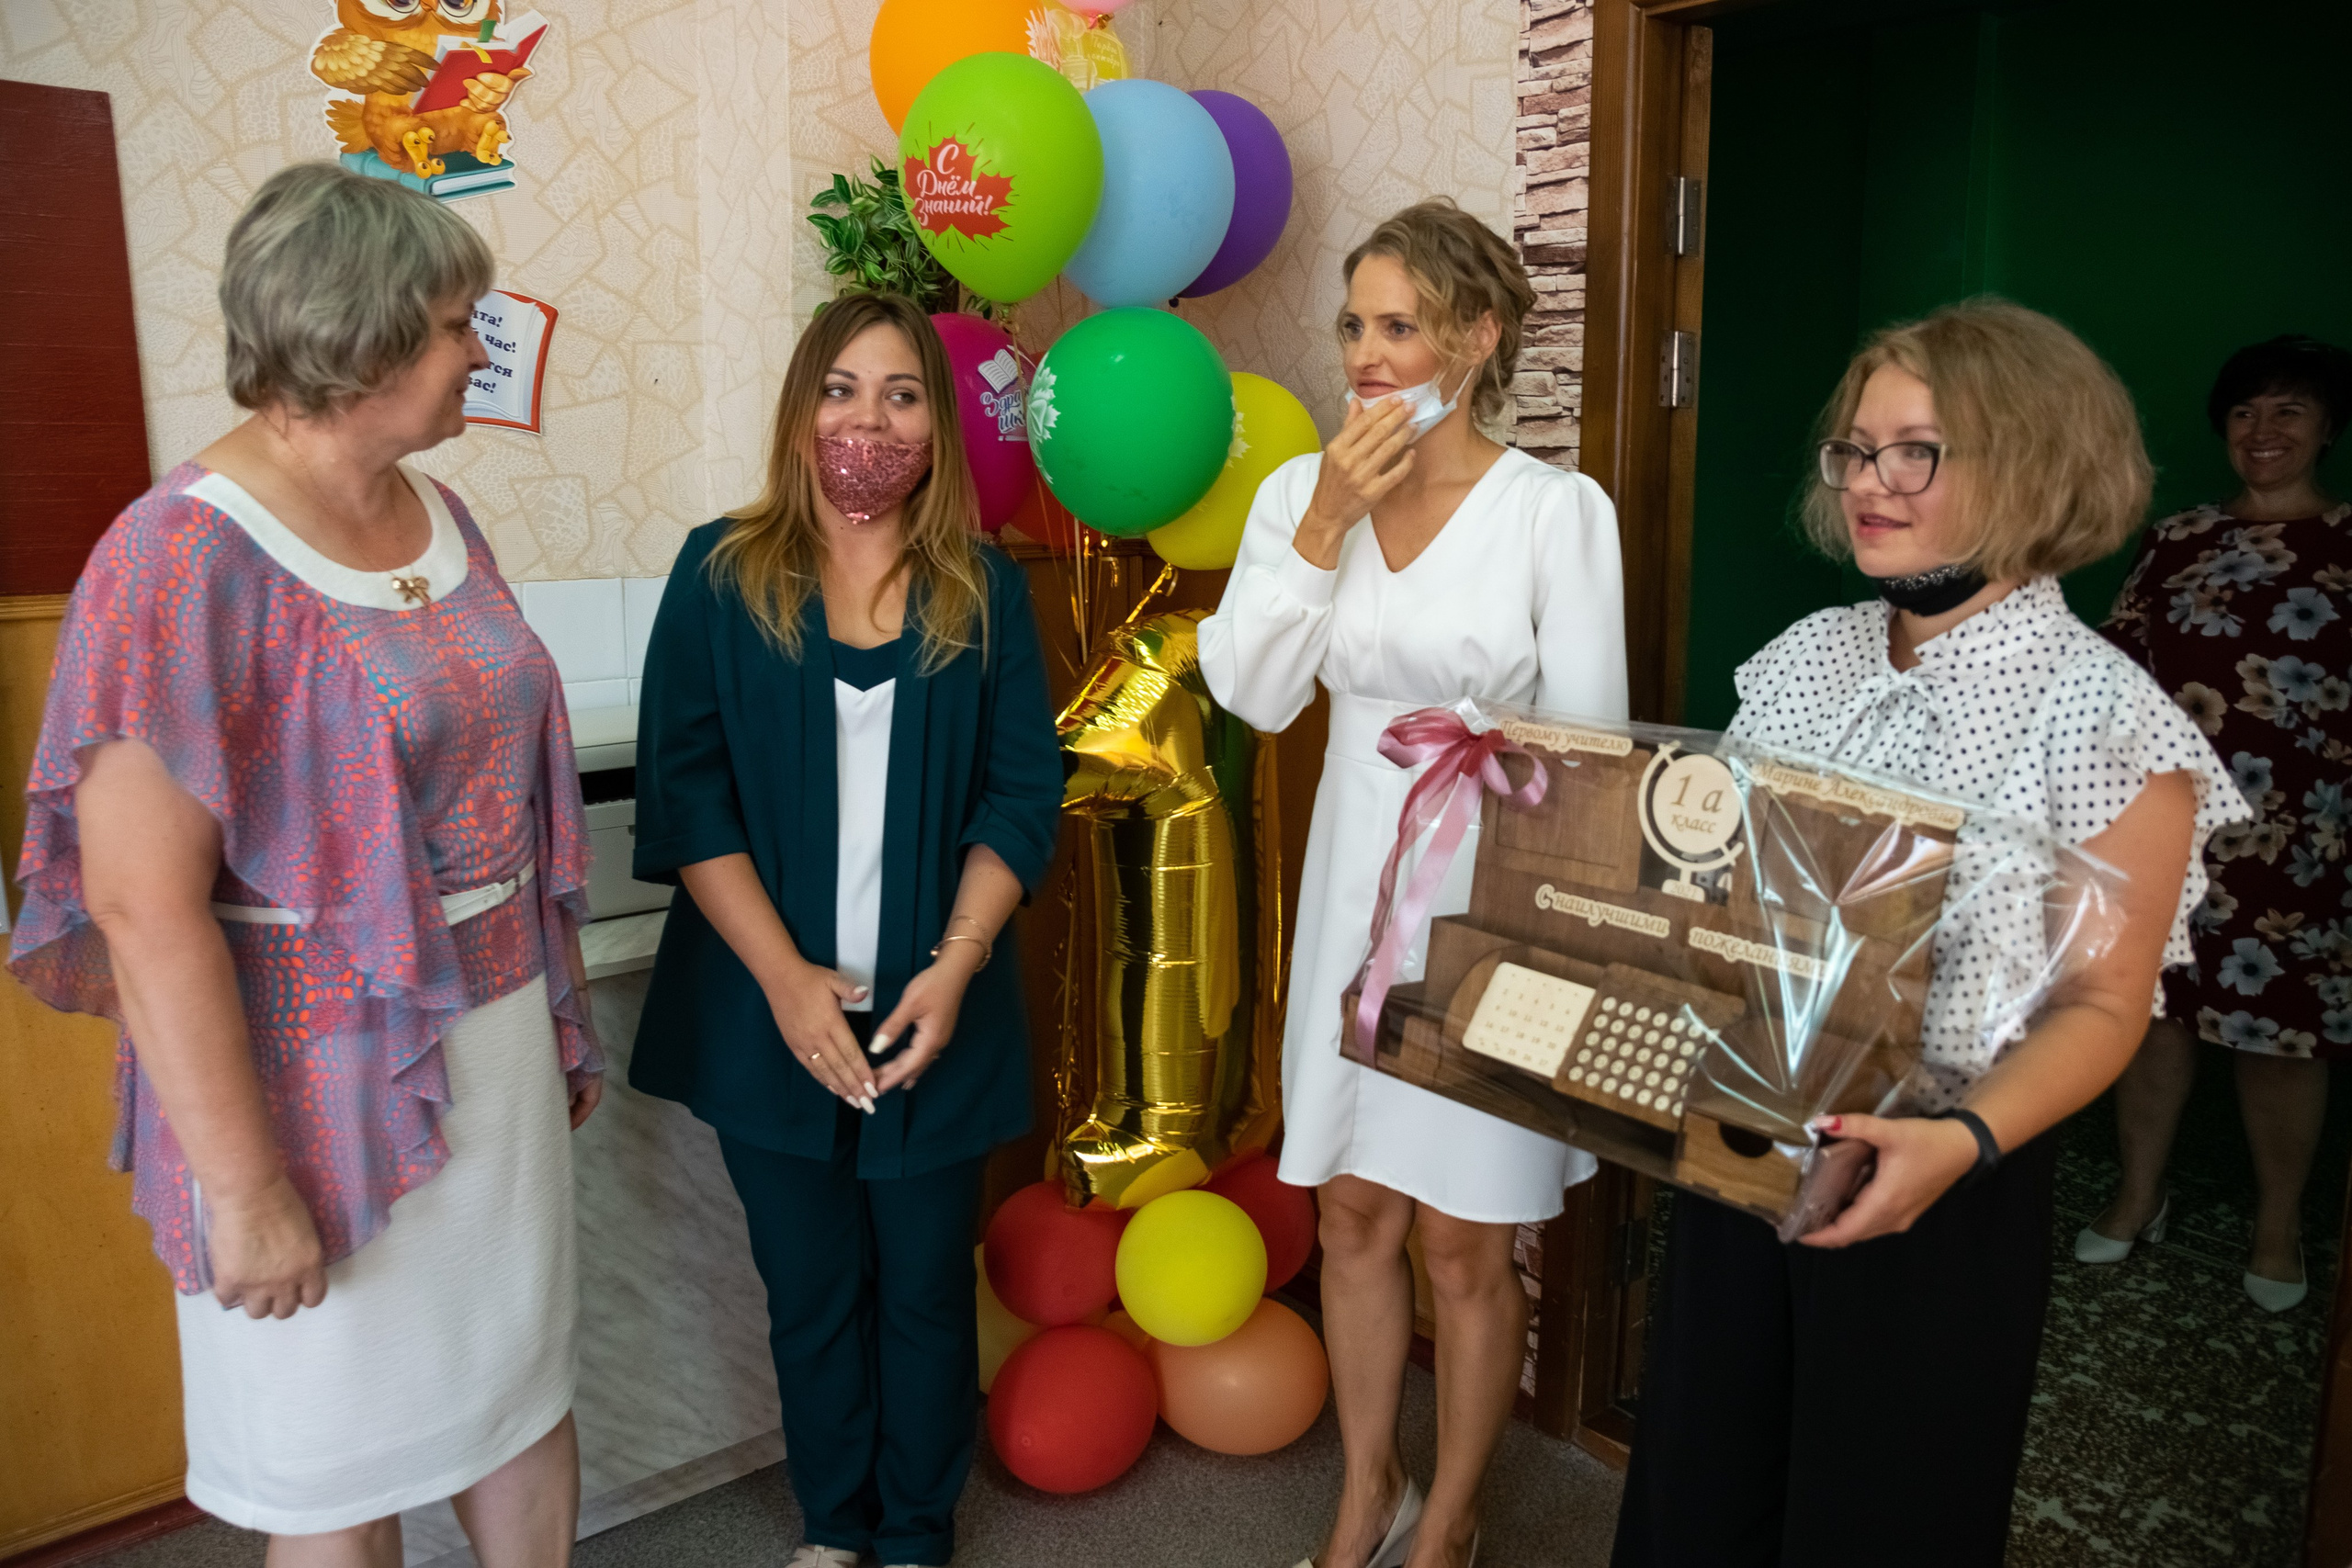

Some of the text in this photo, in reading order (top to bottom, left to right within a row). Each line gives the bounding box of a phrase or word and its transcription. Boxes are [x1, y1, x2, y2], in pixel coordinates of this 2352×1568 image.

[936, 143, 960, 175] С
[916, 169, 978, 198] Днём
[484, 333, 516, 354] час!
[979, 389, 1023, 417] Здра
[1501, 719, 1630, 751] Первому учителю
[1757, 761, 1820, 791] Марине
[1669, 773, 1724, 814] 1 а
[1670, 814, 1718, 834] класс
[1537, 885, 1554, 908] С
[1555, 895, 1668, 935] наилучшими
